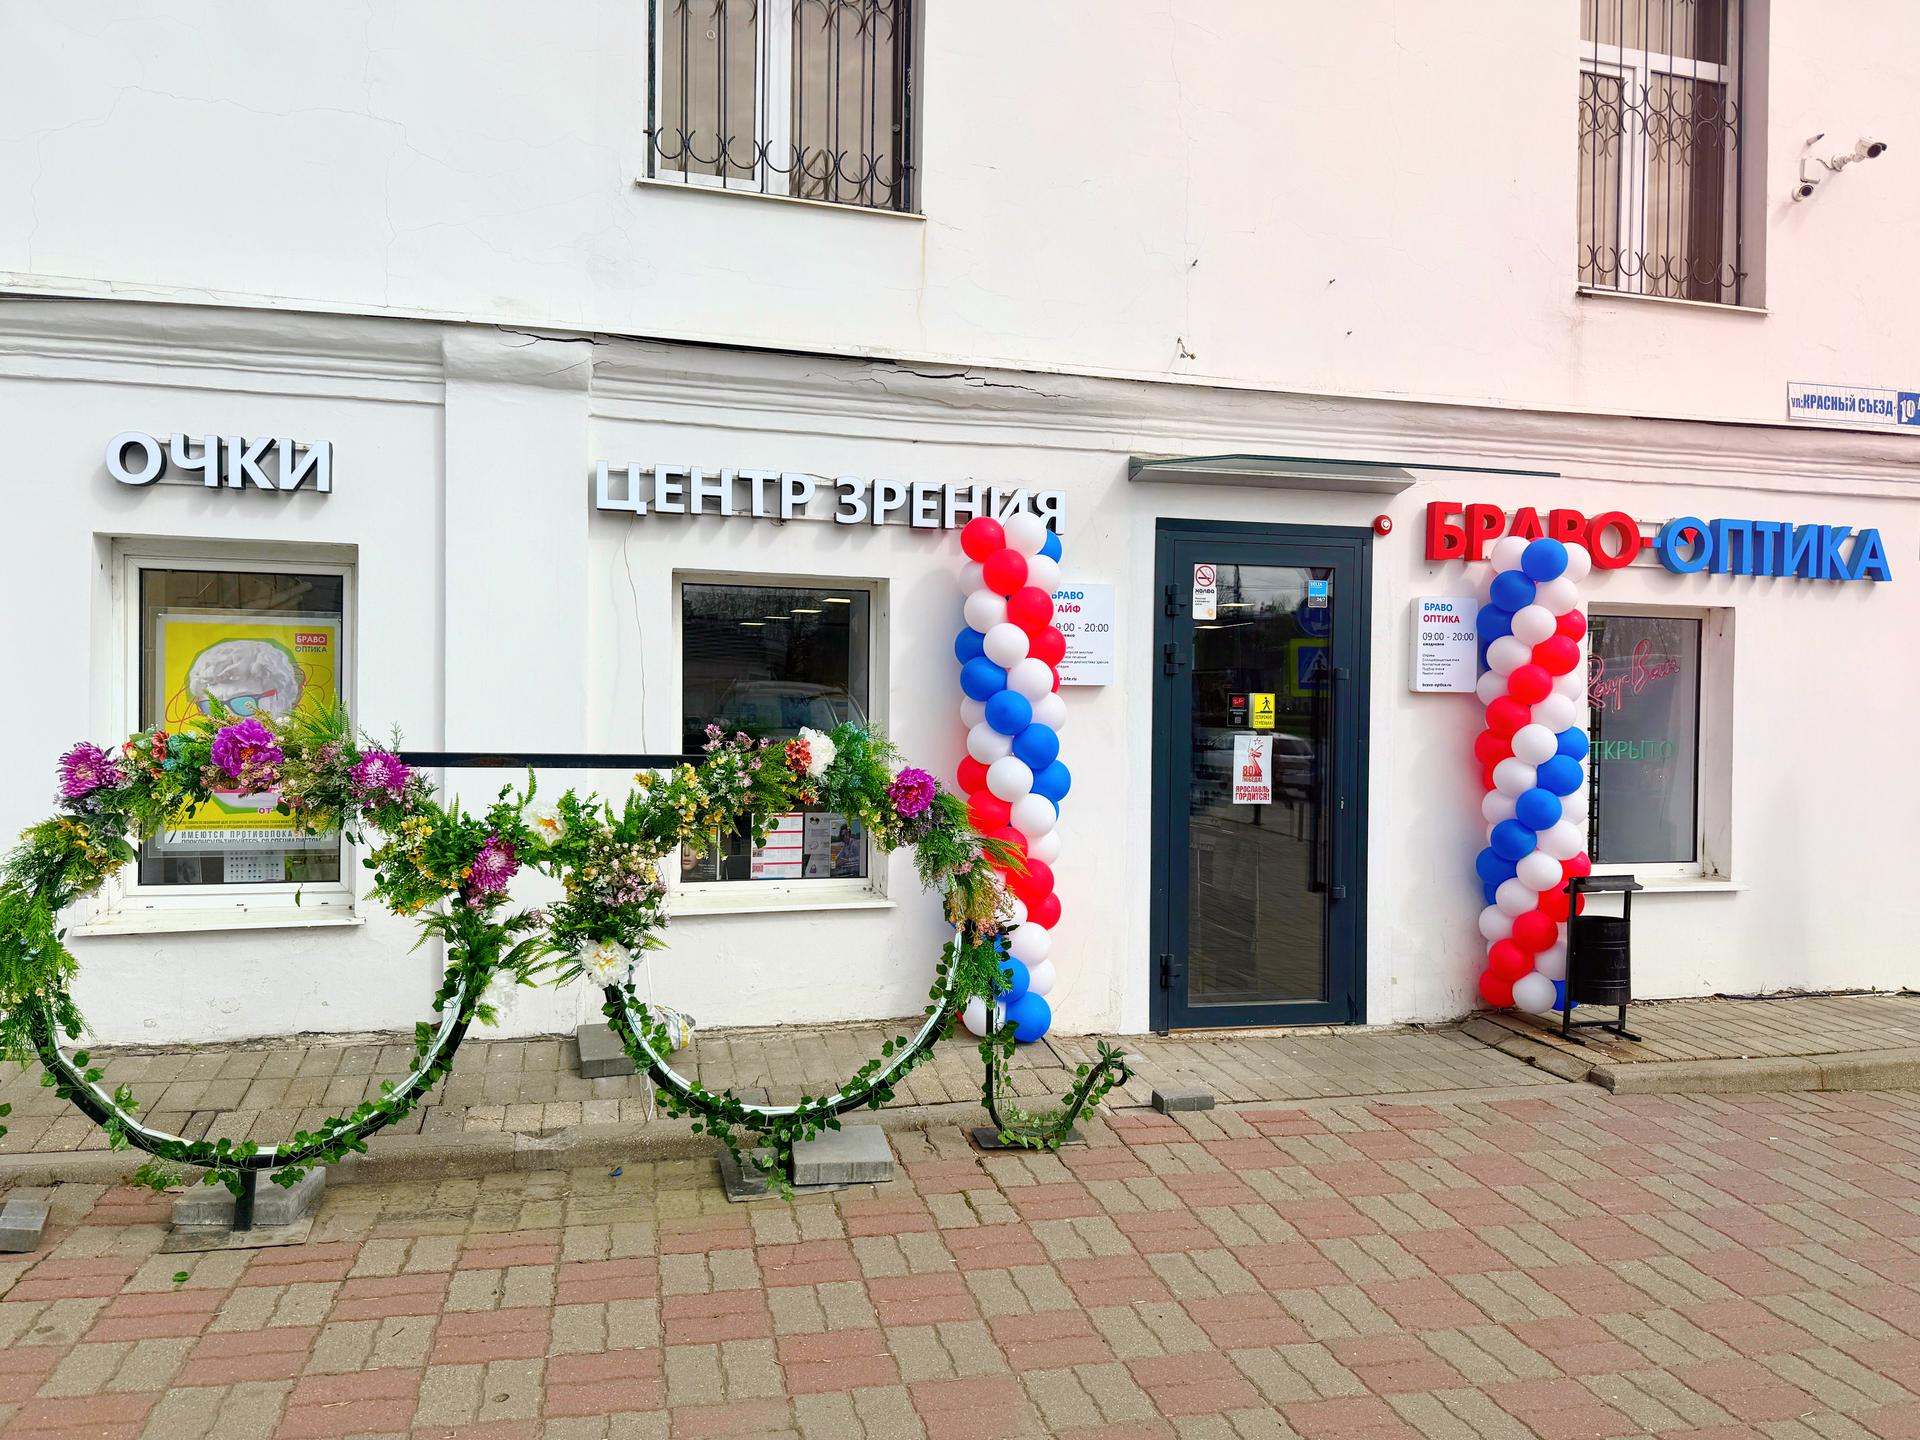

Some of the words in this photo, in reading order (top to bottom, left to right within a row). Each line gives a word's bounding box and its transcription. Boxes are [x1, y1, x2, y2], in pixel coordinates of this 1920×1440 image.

[1858, 398, 1893, 417] СЪЕЗД
[106, 431, 333, 493] ОЧКИ
[595, 460, 816, 520] ЦЕНТР
[834, 476, 1066, 536] ЗРЕНИЯ
[1056, 603, 1081, 613] АЙФ
[1424, 603, 1453, 612] БРАВО
[1423, 615, 1461, 623] ОПТИКА
[1084, 624, 1109, 632] 20:00
[296, 635, 326, 643] БРАВО
[1422, 632, 1444, 641] 09:00
[1452, 633, 1474, 641] 20:00
[1590, 740, 1677, 760] ТКРЫТО
[1235, 785, 1270, 793] ЯРОСЛАВЛЬ
[1235, 793, 1270, 802] ГОРДИТСЯ!
[181, 831, 224, 839] ИМЕЮТСЯ
